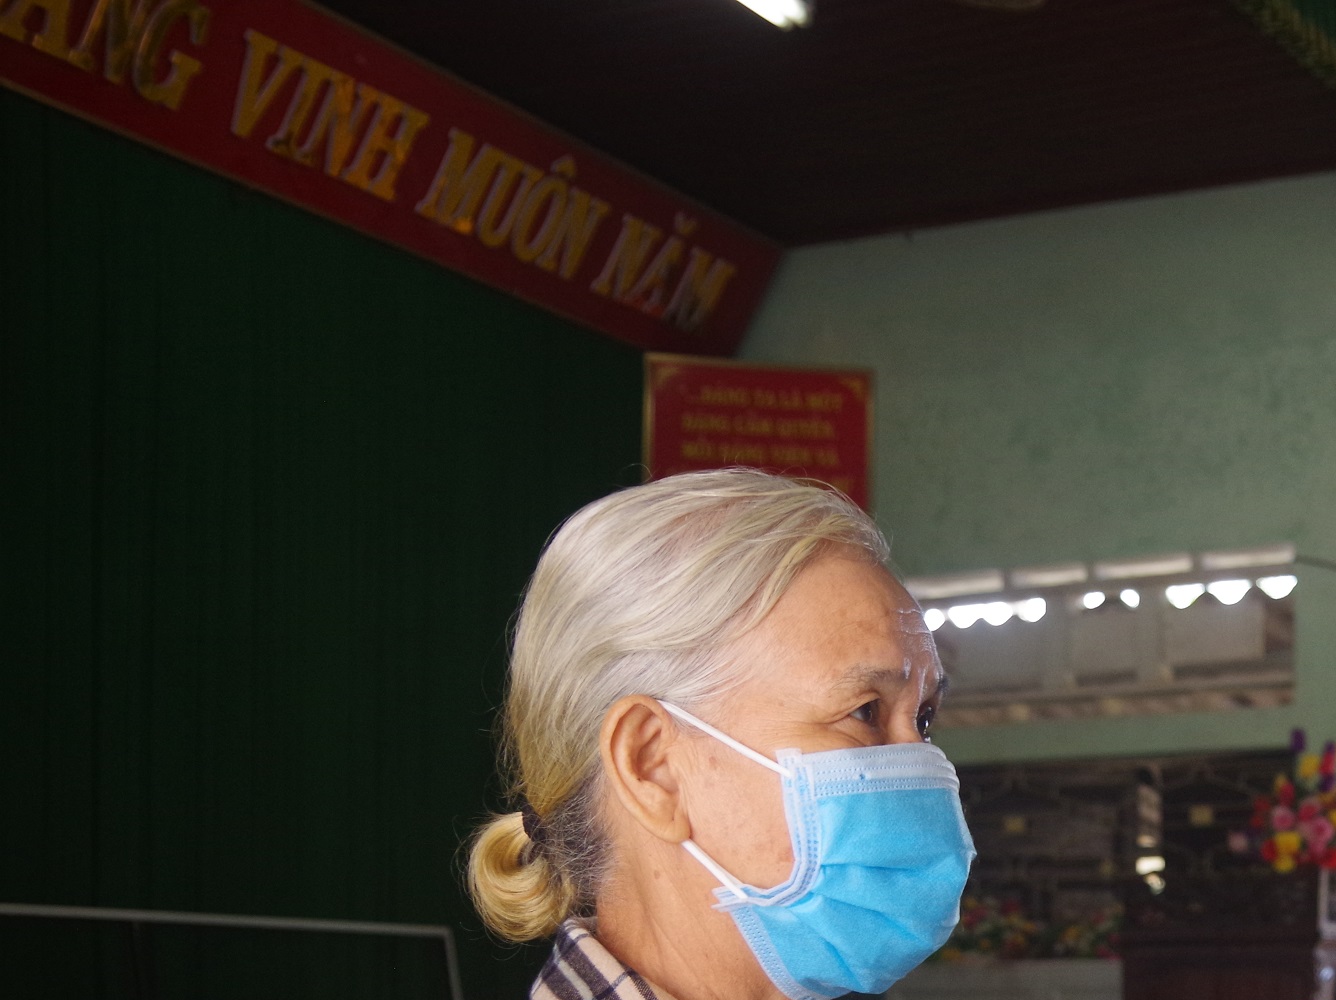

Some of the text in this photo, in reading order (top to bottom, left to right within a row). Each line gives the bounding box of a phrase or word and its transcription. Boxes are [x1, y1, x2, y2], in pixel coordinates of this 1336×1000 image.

[230, 29, 431, 203] VINH
[416, 130, 611, 280] MUÔN
[593, 213, 737, 331] NĂM
